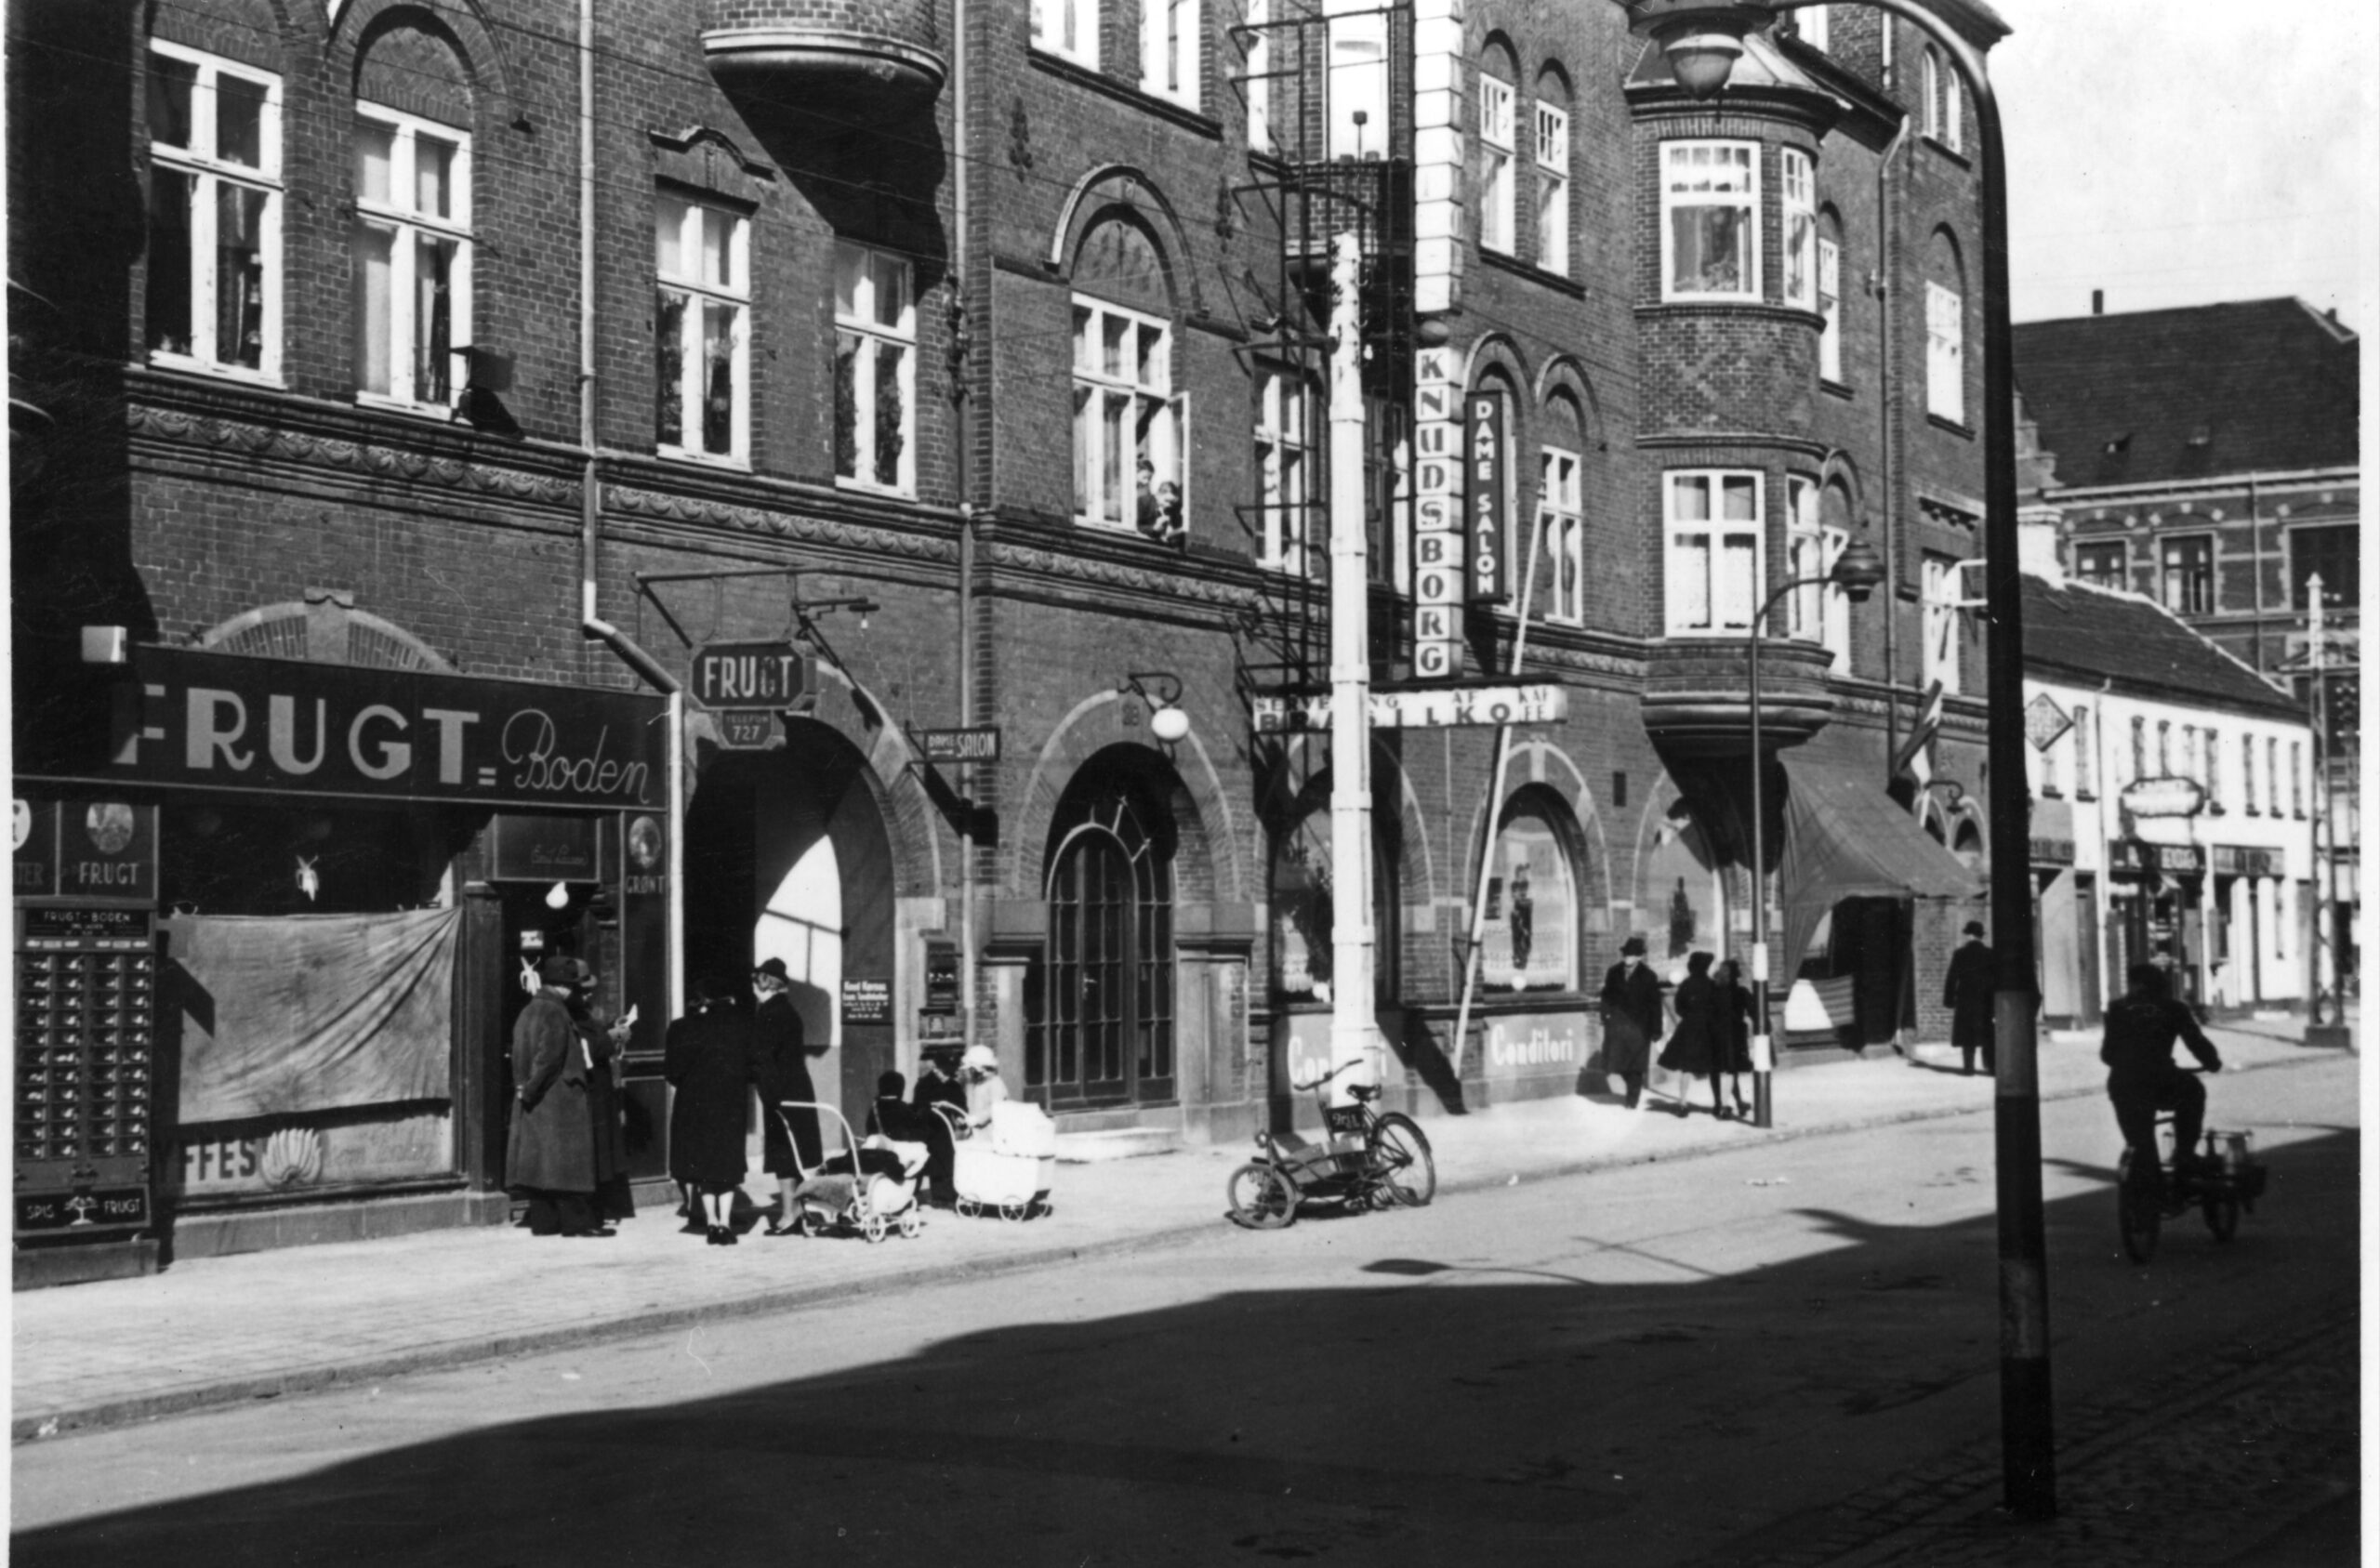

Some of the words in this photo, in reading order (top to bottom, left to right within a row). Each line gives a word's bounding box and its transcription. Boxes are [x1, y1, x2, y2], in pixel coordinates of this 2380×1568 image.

[1474, 400, 1495, 481] DAME
[1419, 354, 1446, 672] KNUDSBORG
[1475, 494, 1496, 594] SALON
[704, 655, 795, 698] FRUGT
[732, 725, 760, 742] 727
[956, 731, 997, 758] SALON
[501, 708, 650, 805] Boden
[79, 861, 139, 885] FRUGT
[1490, 1023, 1573, 1066] Conditori
